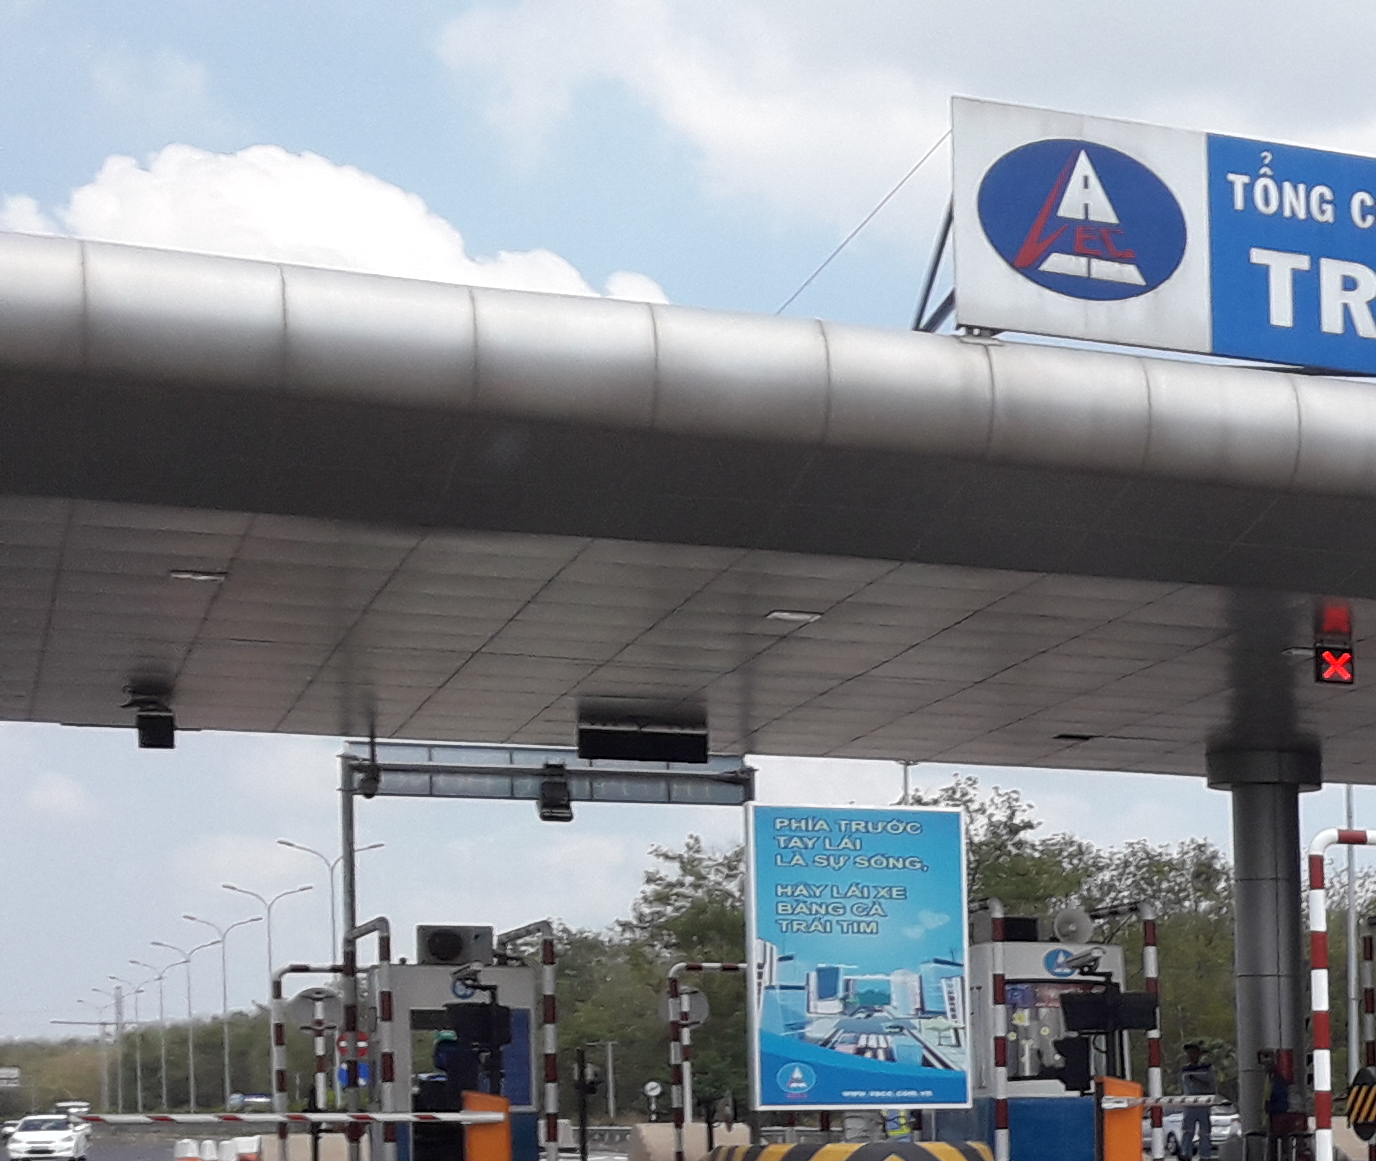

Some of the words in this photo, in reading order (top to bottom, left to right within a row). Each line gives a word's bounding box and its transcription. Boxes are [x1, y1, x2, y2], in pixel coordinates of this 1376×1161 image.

[1226, 150, 1335, 224] TỔNG
[774, 816, 831, 832] PHÍA
[838, 818, 923, 835] TRƯỚC
[775, 836, 818, 849] TAY
[825, 834, 862, 850] LÁI
[776, 851, 806, 867] LÀ
[813, 854, 849, 870] SỰ
[775, 882, 827, 898] HÃY
[831, 882, 869, 899] LÁI
[873, 886, 907, 899] XE
[776, 917, 832, 933] TRÁI
[838, 920, 879, 934] TIM
